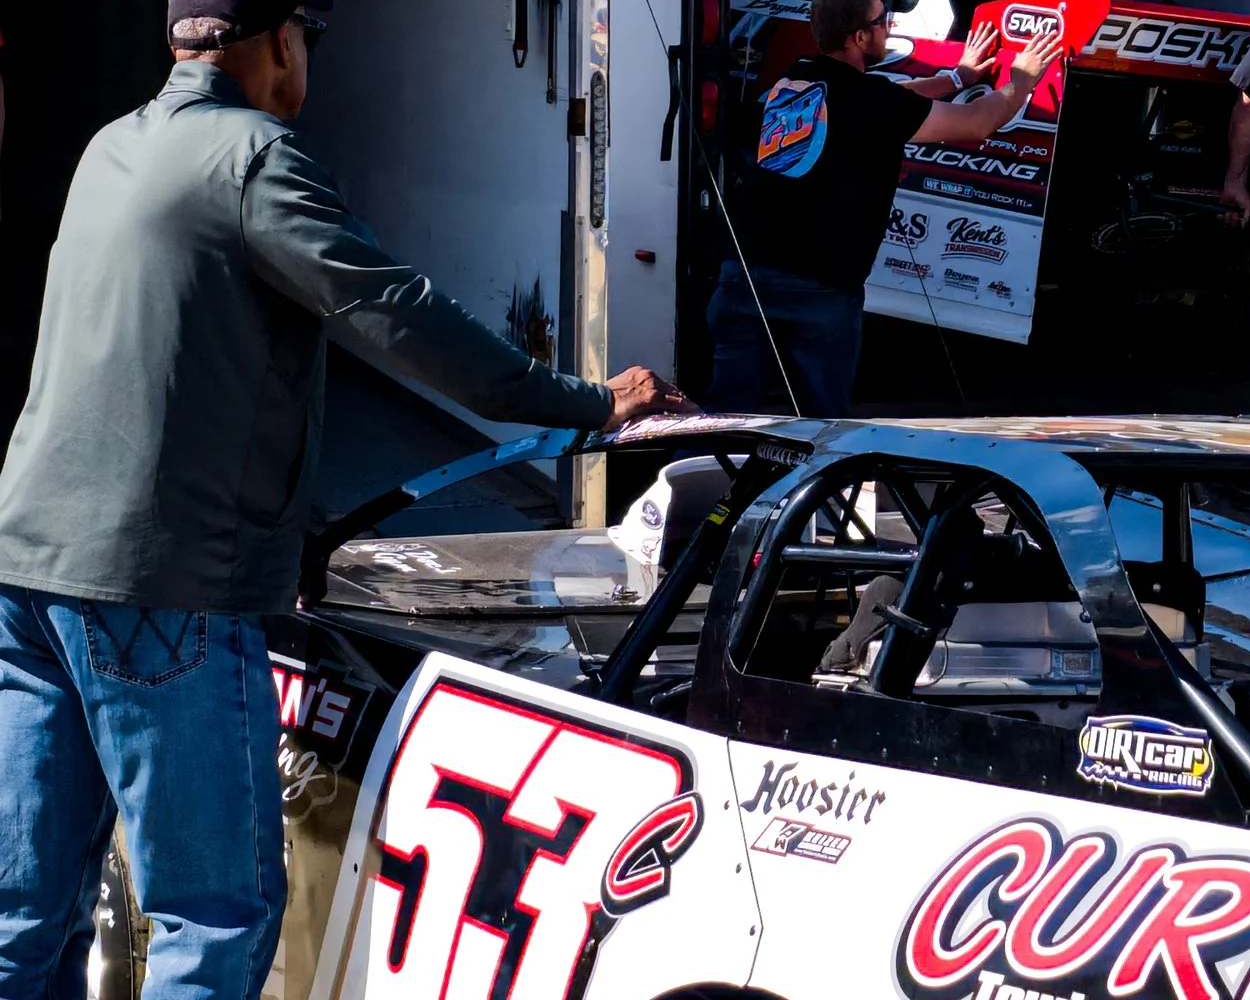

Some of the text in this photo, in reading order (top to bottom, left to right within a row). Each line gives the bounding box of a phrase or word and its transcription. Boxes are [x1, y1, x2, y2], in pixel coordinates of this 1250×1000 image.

[903, 143, 1040, 181] RUCKING
[946, 217, 1006, 246] Kent's
[270, 666, 352, 740] W'S
[1087, 726, 1205, 774] DIRTcar
[739, 759, 886, 825] Hoosier
[1147, 770, 1203, 787] RACING
